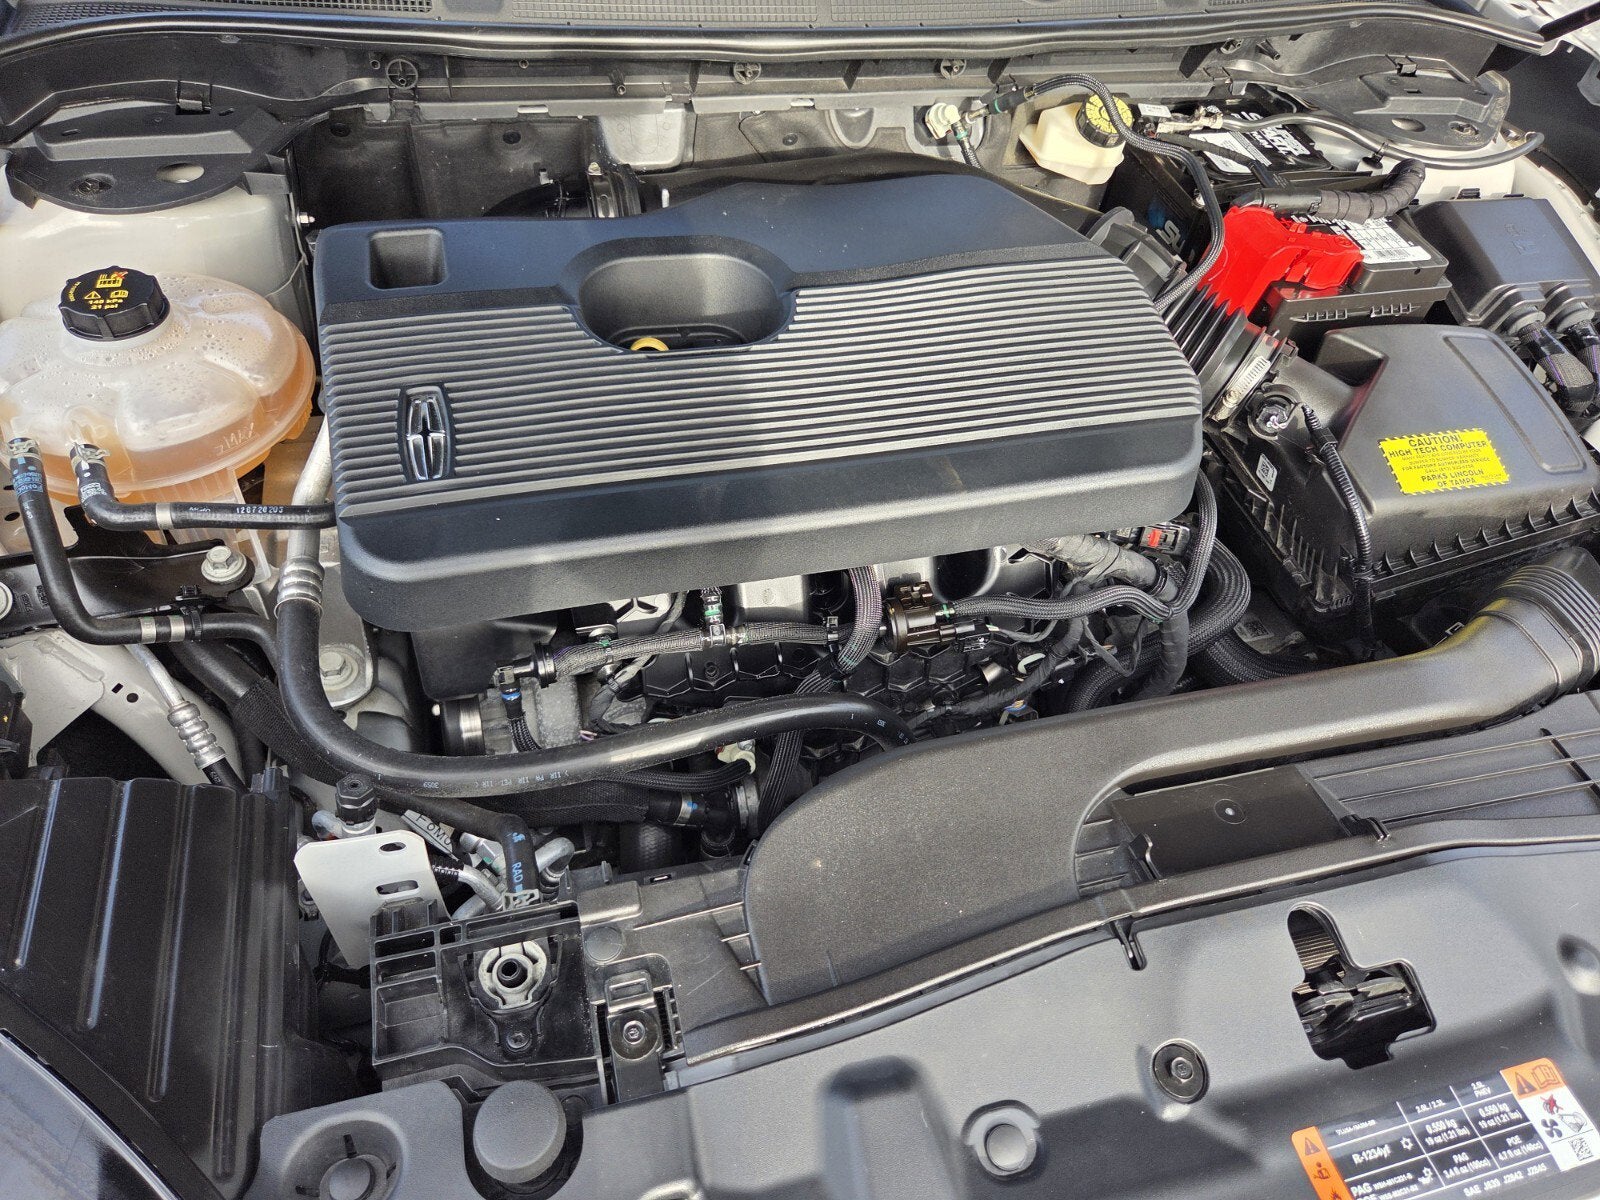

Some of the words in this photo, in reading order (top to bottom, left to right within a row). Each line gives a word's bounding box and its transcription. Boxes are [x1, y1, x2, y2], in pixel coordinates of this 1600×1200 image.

[1408, 434, 1463, 447] CAUTION!
[1389, 448, 1412, 458] HIGH
[1414, 444, 1438, 455] TECH
[1440, 440, 1487, 452] COMPUTER
[1421, 472, 1448, 482] PARKS
[1450, 468, 1484, 479] LINCOLN
[1437, 480, 1448, 488] OF
[1450, 477, 1476, 486] TAMPA
[512, 862, 524, 883] RAD
[1474, 1087, 1491, 1098] PHEV
[1479, 1104, 1499, 1118] 0.550
[1497, 1102, 1510, 1113] kg
[1425, 1120, 1447, 1135] 0.550
[1445, 1118, 1458, 1130] kg
[1479, 1120, 1487, 1129] 19
[1425, 1135, 1434, 1146] 19
[1506, 1135, 1522, 1147] POE
[1351, 1144, 1391, 1165] R-1234yf
[1452, 1152, 1469, 1164] PAG
[1350, 1182, 1372, 1197] PAG
[1463, 1184, 1481, 1196] SAE
